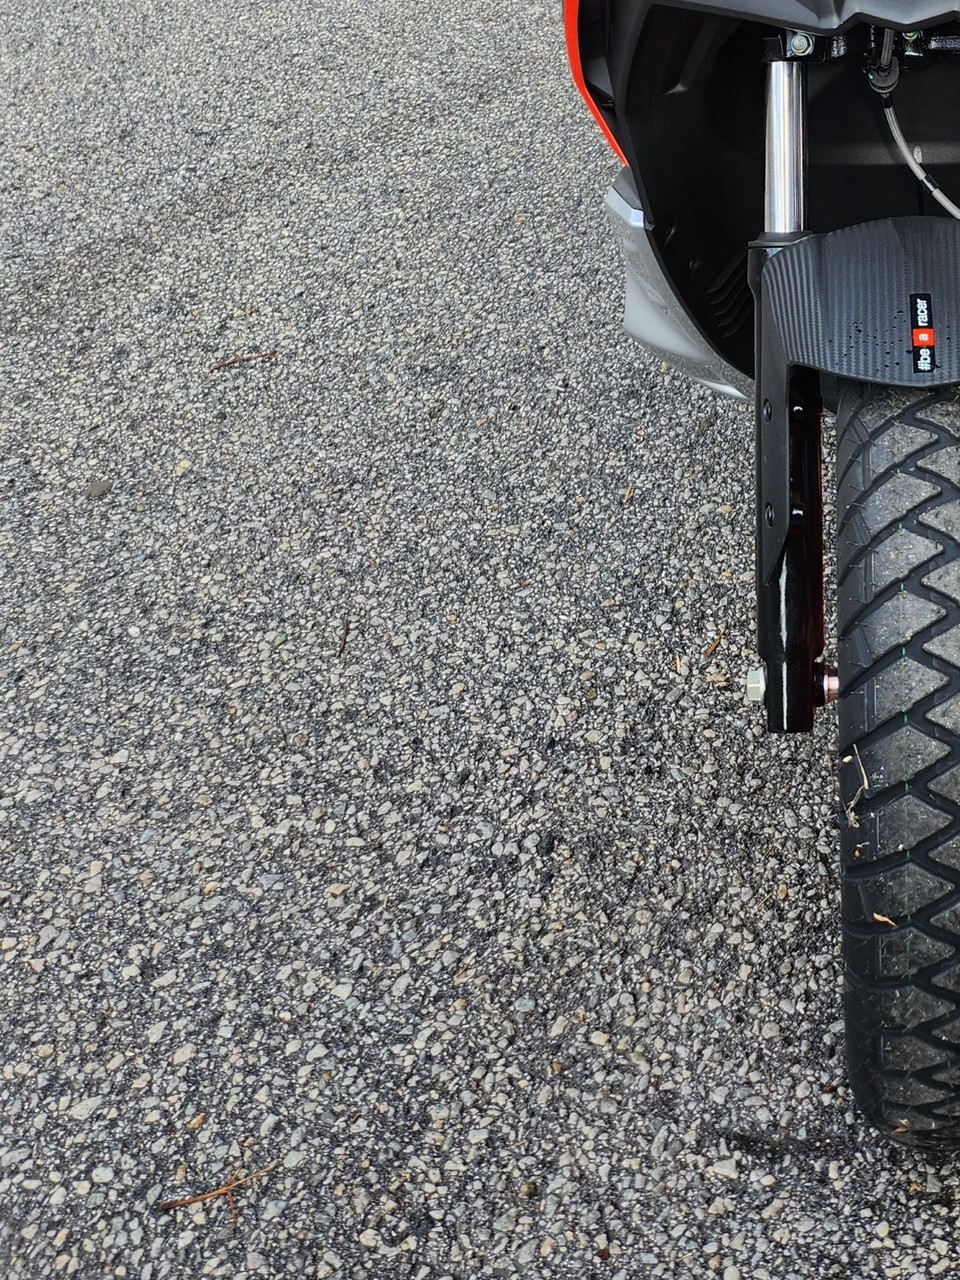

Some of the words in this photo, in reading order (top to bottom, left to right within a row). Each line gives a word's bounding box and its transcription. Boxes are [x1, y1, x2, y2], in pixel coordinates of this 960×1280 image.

[916, 298, 929, 327] racer
[918, 333, 929, 342] a
[917, 348, 931, 371] #be
